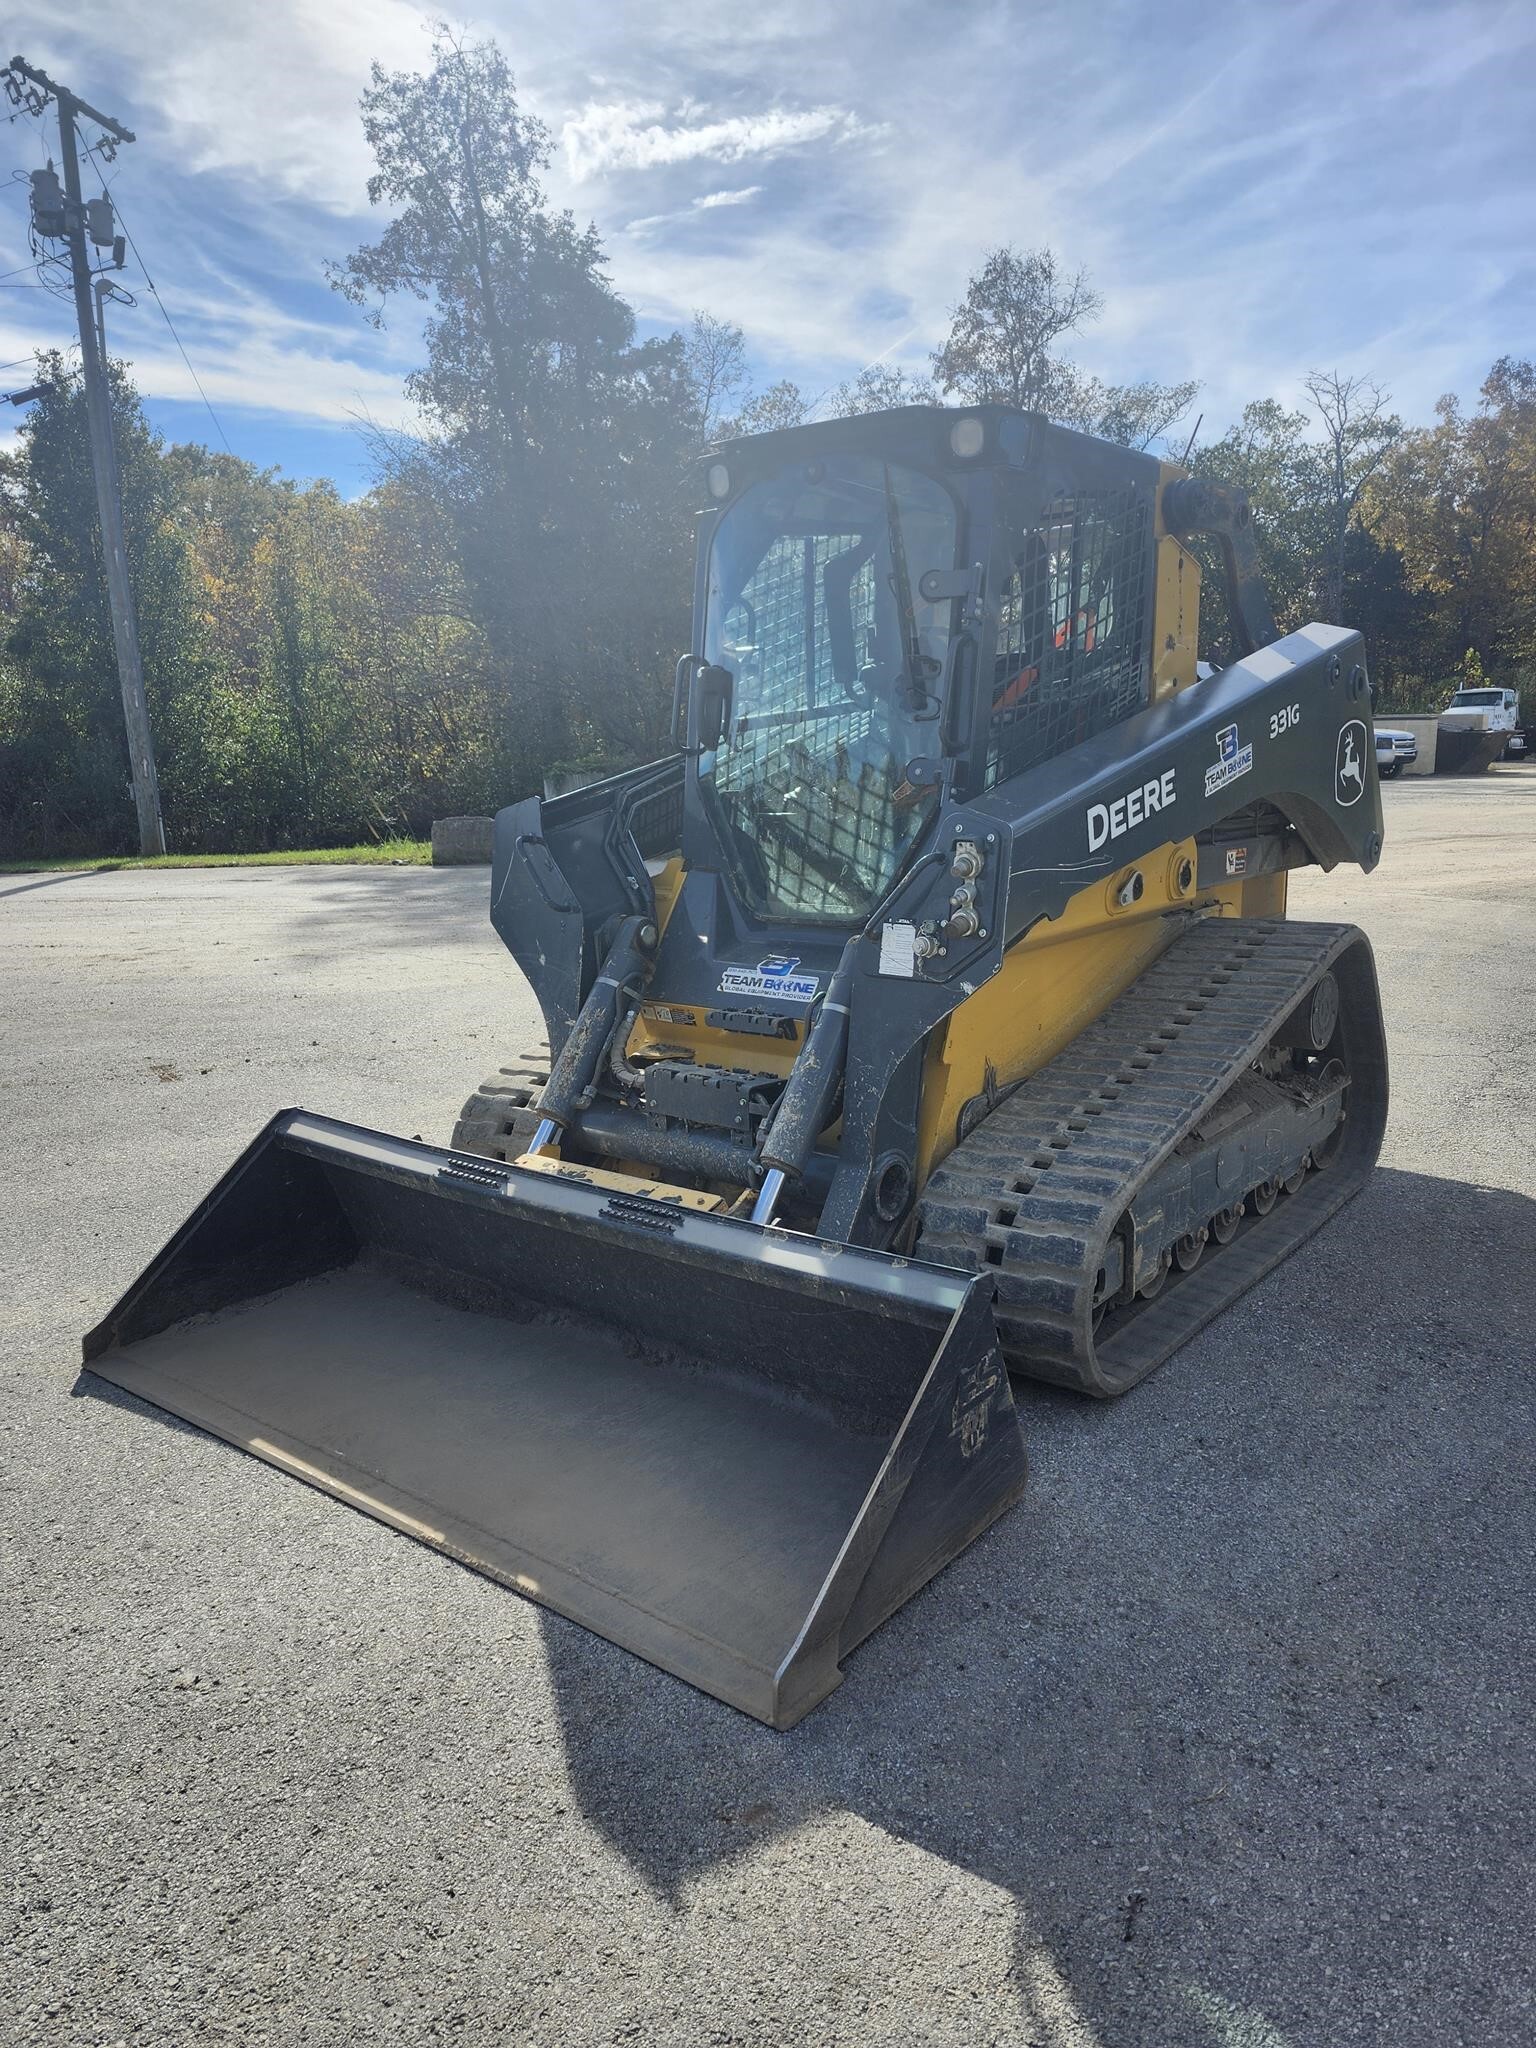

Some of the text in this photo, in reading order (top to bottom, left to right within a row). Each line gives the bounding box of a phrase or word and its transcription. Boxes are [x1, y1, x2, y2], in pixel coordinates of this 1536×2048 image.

[1269, 703, 1300, 739] 331G
[1205, 765, 1228, 788] TEAM
[1227, 751, 1252, 775] BOONE
[1086, 767, 1177, 853] DEERE
[723, 973, 816, 994] TEAM BOONE
[724, 985, 811, 1001] GLOBAL EQUIPMENT PROVIDER
